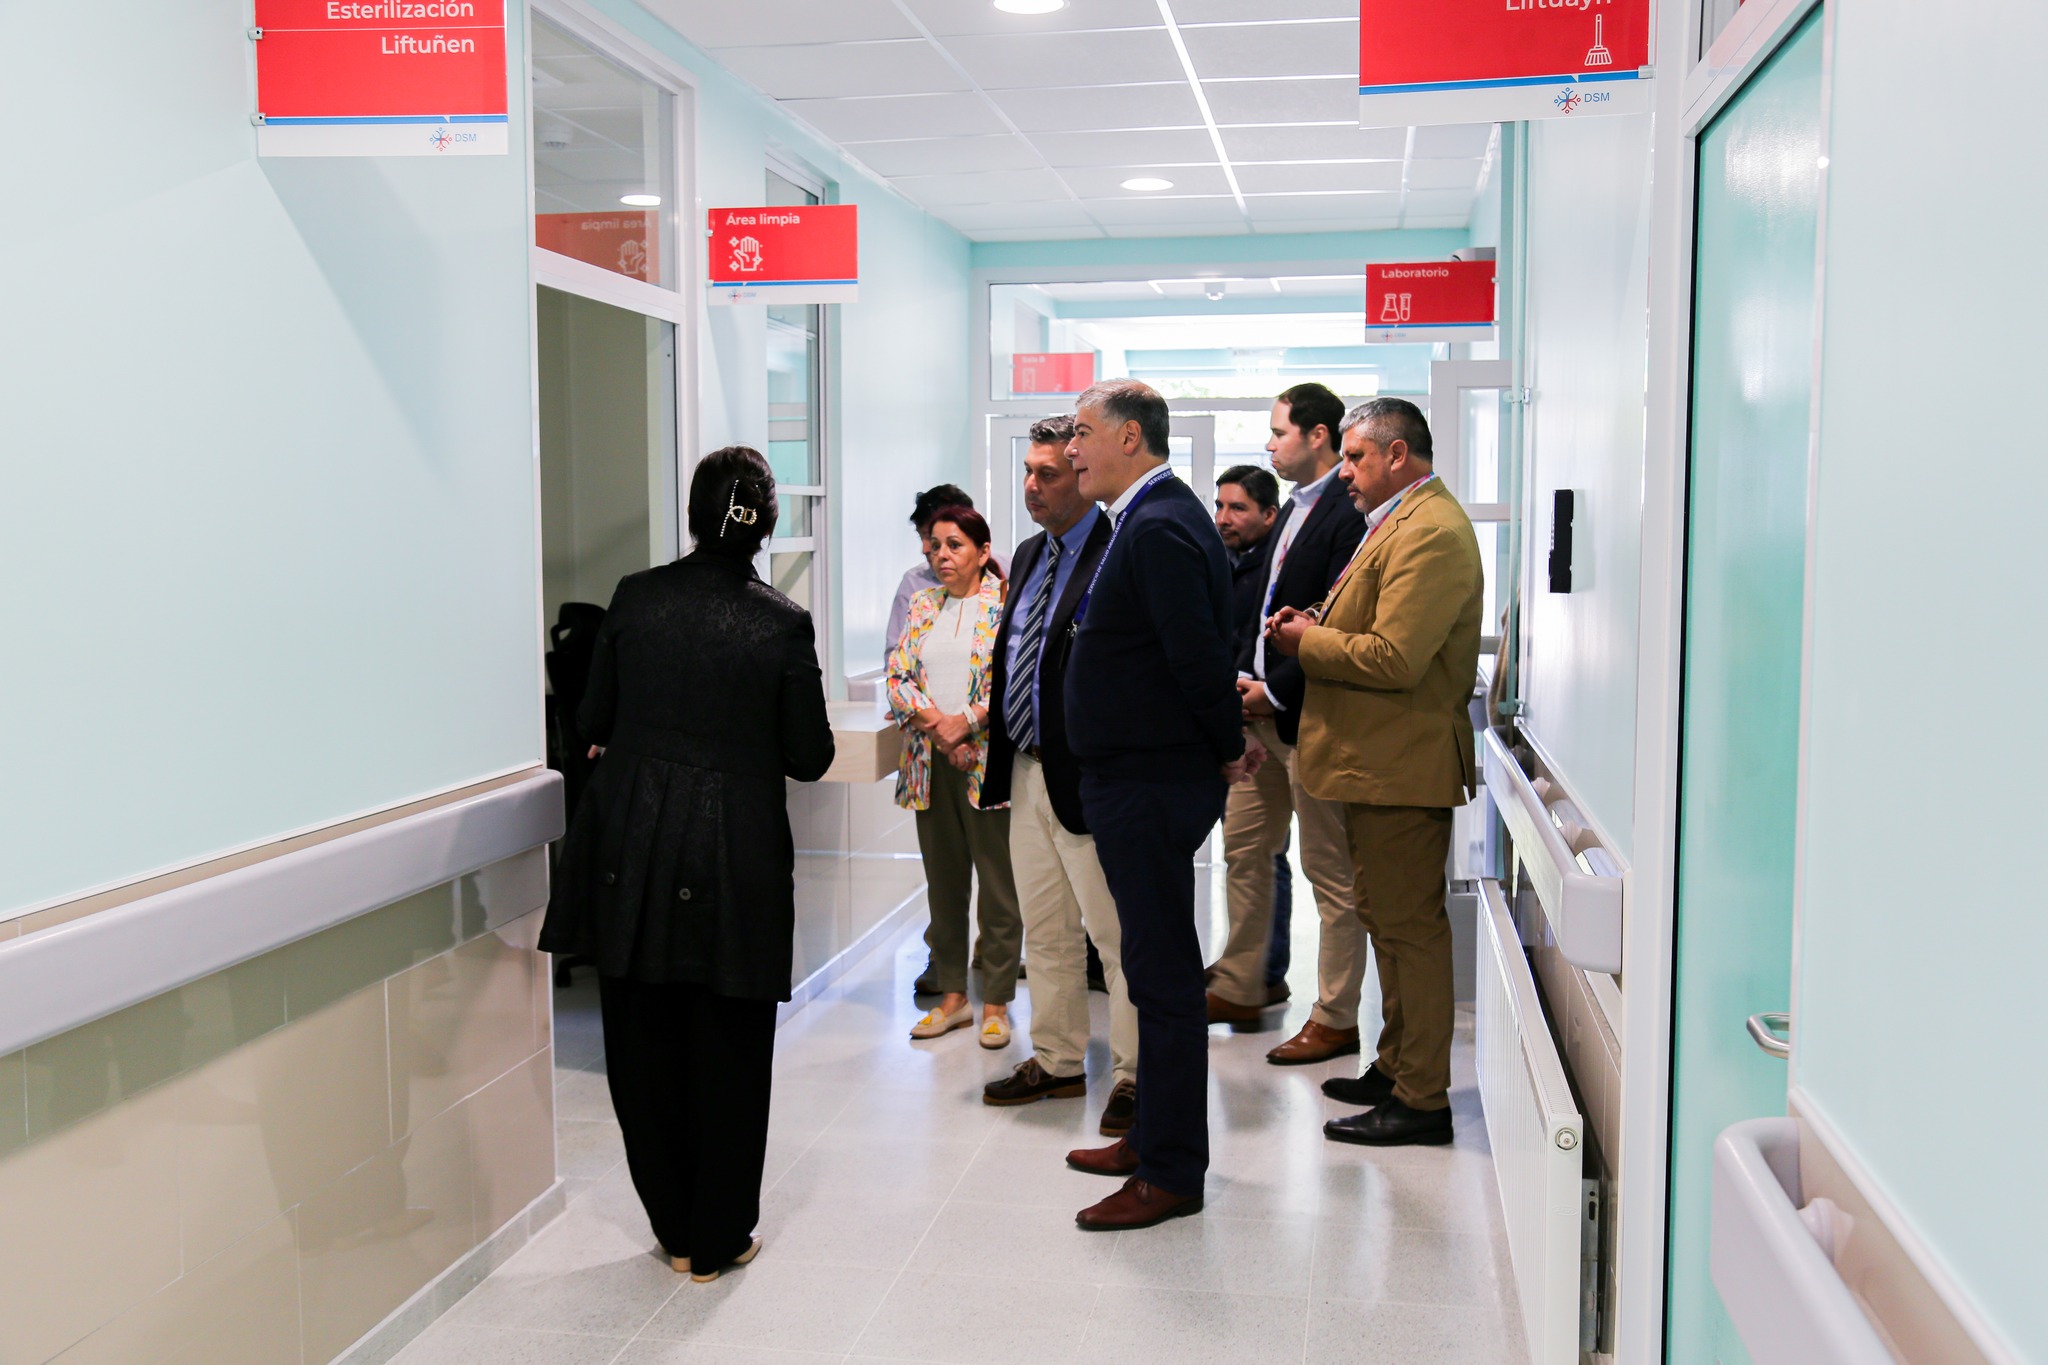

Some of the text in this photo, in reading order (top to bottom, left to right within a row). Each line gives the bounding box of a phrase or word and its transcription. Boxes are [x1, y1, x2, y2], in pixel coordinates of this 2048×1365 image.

[326, 0, 475, 20] Esterilización
[381, 34, 475, 55] Liftuñen
[1584, 92, 1610, 103] DSM
[454, 133, 477, 143] DSM
[726, 212, 800, 227] Área limpia
[1382, 267, 1449, 278] Laboratorio
[1147, 472, 1167, 486] SERVICIO
[1087, 572, 1099, 594] SERVICIO
[1097, 565, 1102, 573] DE
[1100, 549, 1110, 566] SALUD
[1120, 510, 1128, 522] SUR
